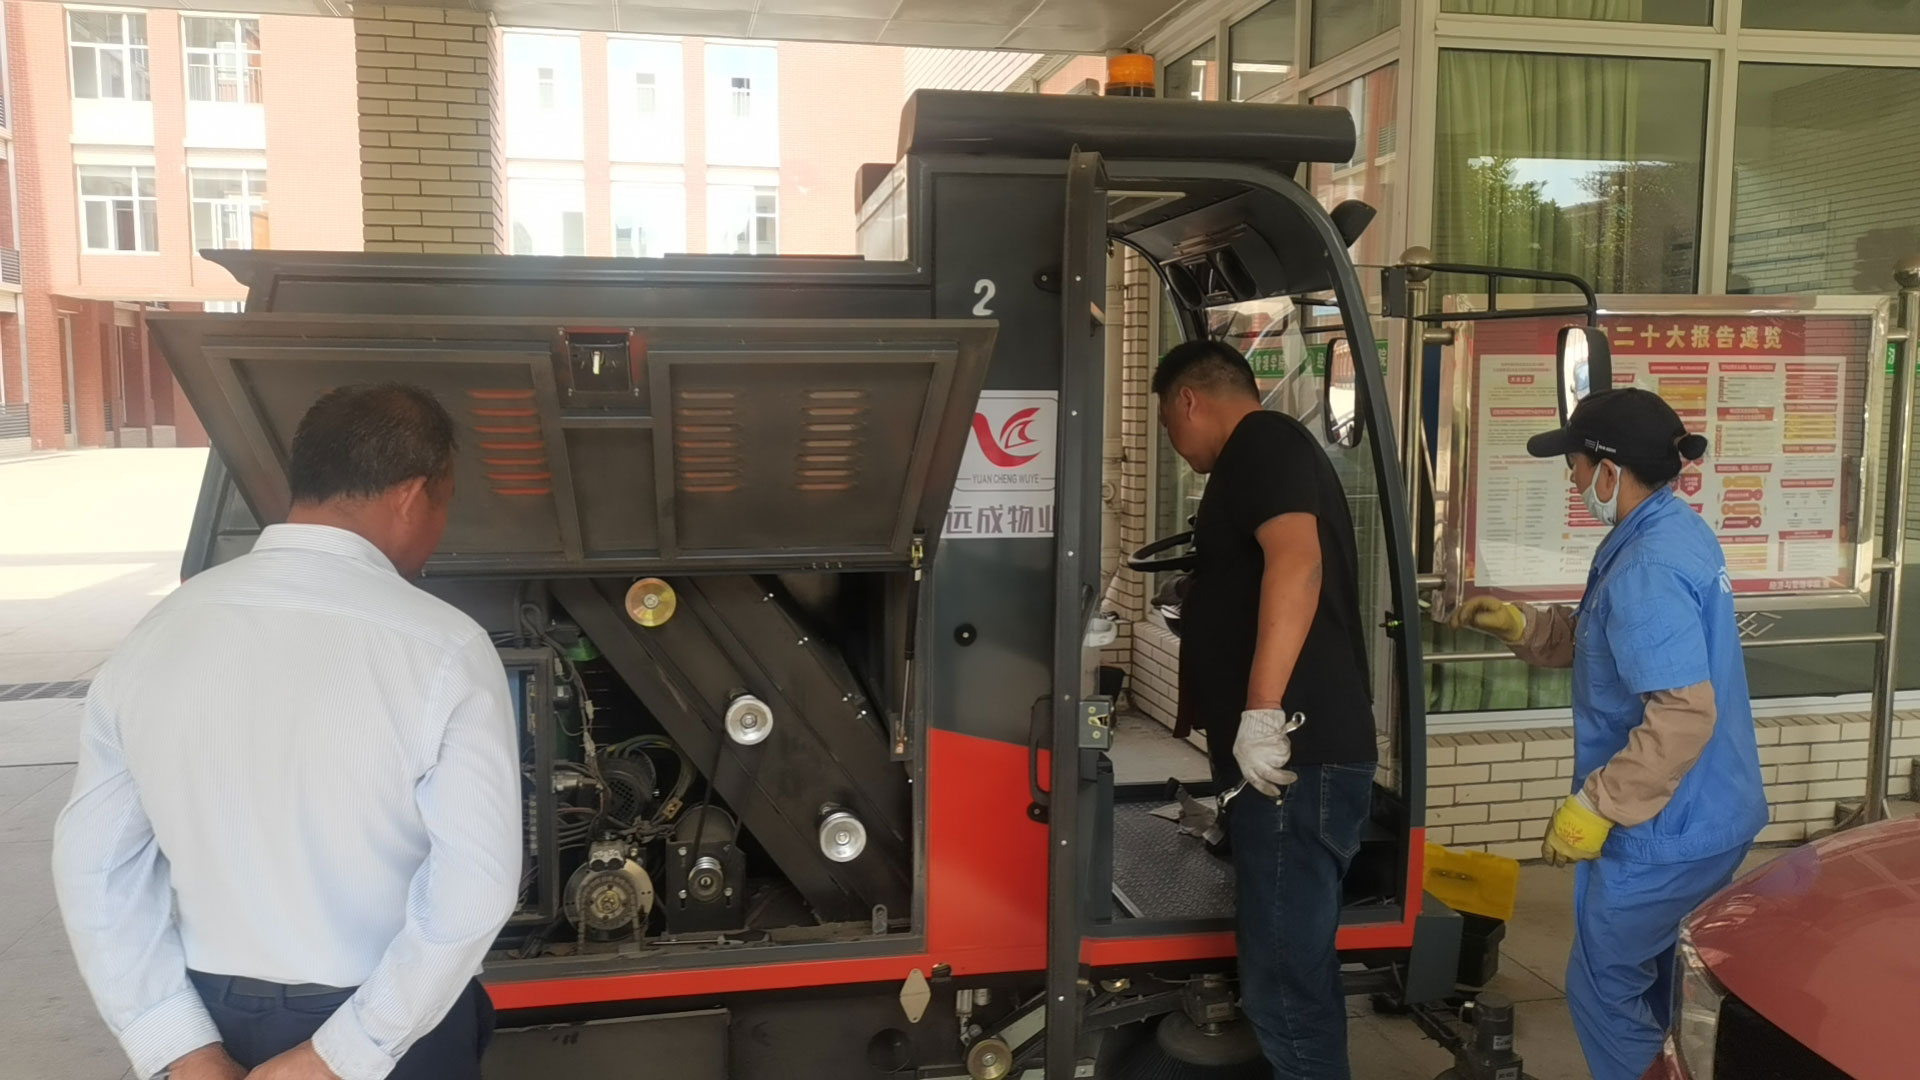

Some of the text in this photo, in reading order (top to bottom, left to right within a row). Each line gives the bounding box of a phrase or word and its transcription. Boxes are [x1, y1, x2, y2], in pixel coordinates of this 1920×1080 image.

[972, 279, 995, 315] 2
[972, 473, 1040, 484] YUAN CHENG WUYE
